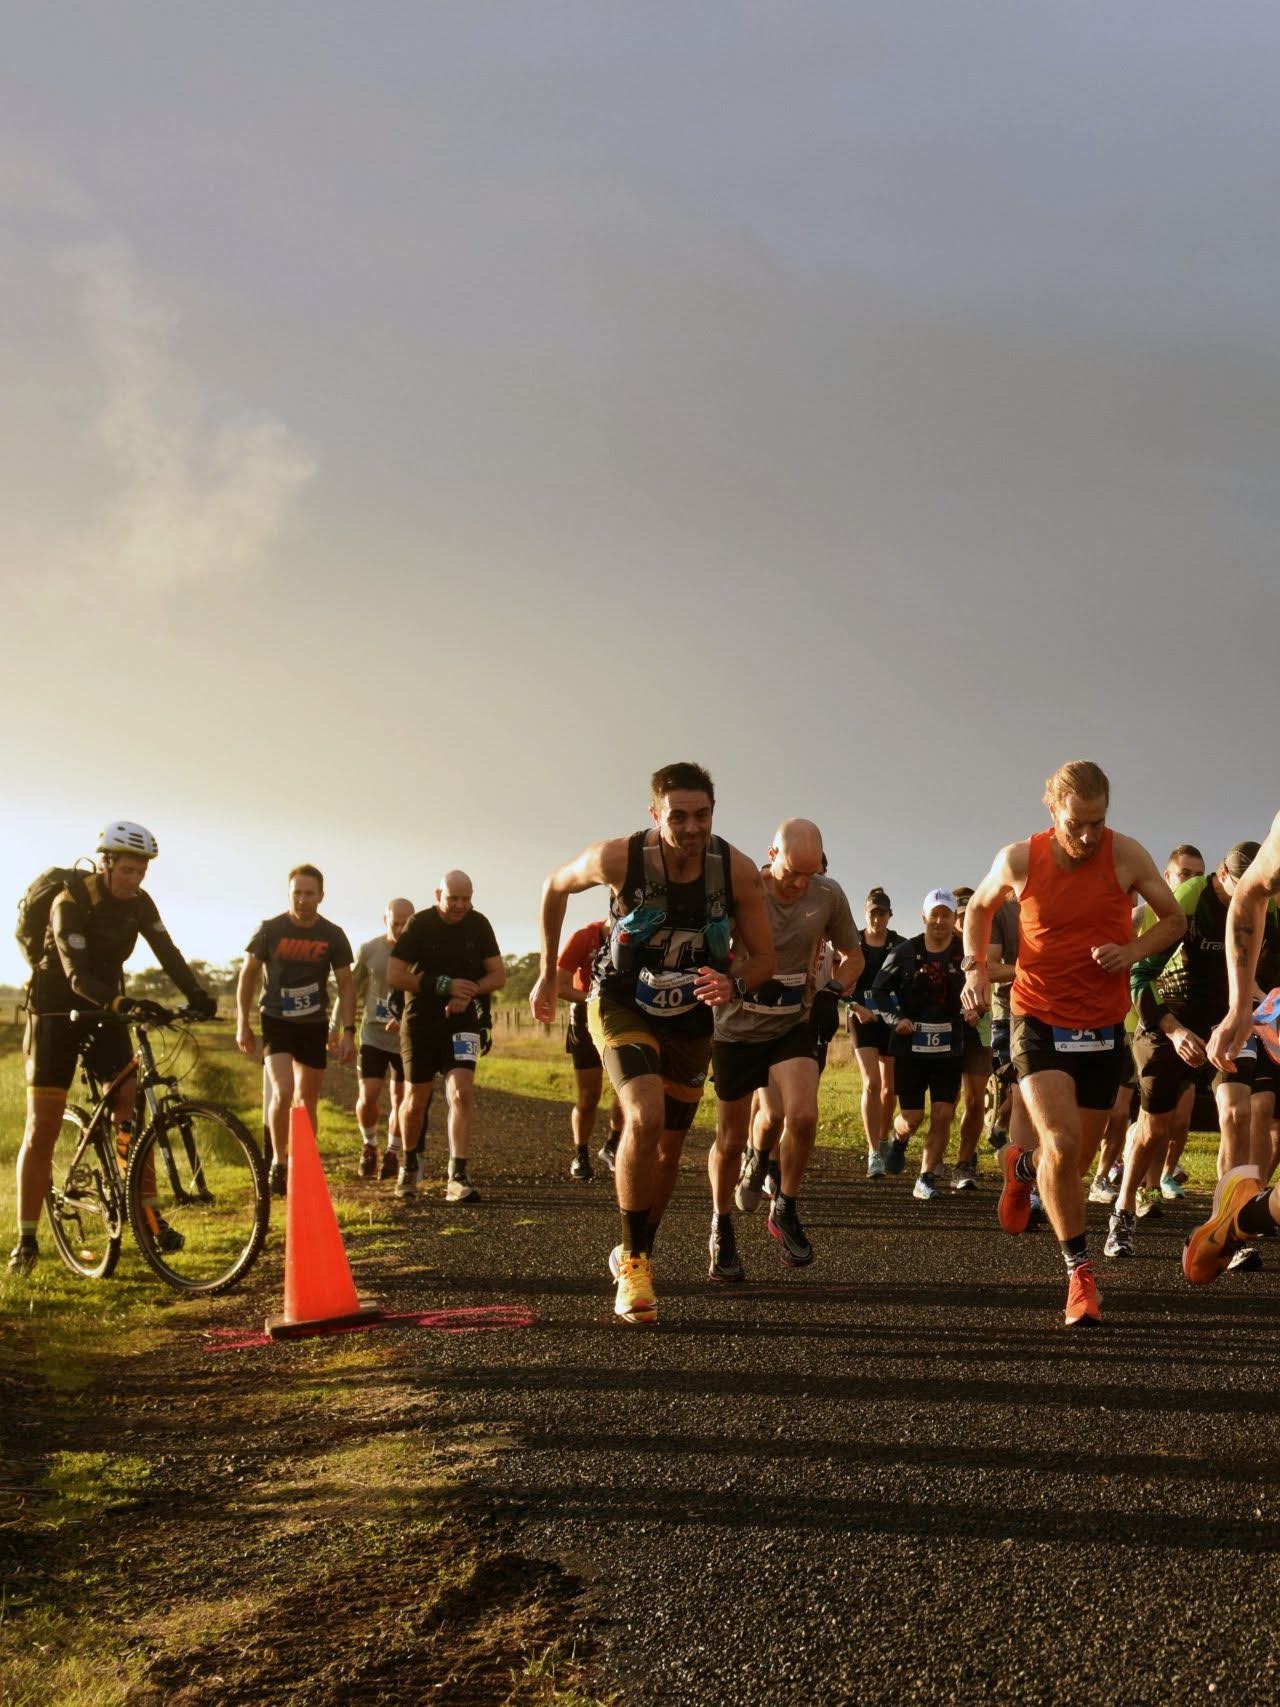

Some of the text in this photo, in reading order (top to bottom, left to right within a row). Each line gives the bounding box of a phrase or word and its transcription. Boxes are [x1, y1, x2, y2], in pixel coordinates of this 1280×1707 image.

[273, 938, 328, 960] NIKE
[294, 995, 311, 1009] 53
[652, 988, 683, 1007] 40
[926, 1033, 940, 1046] 16
